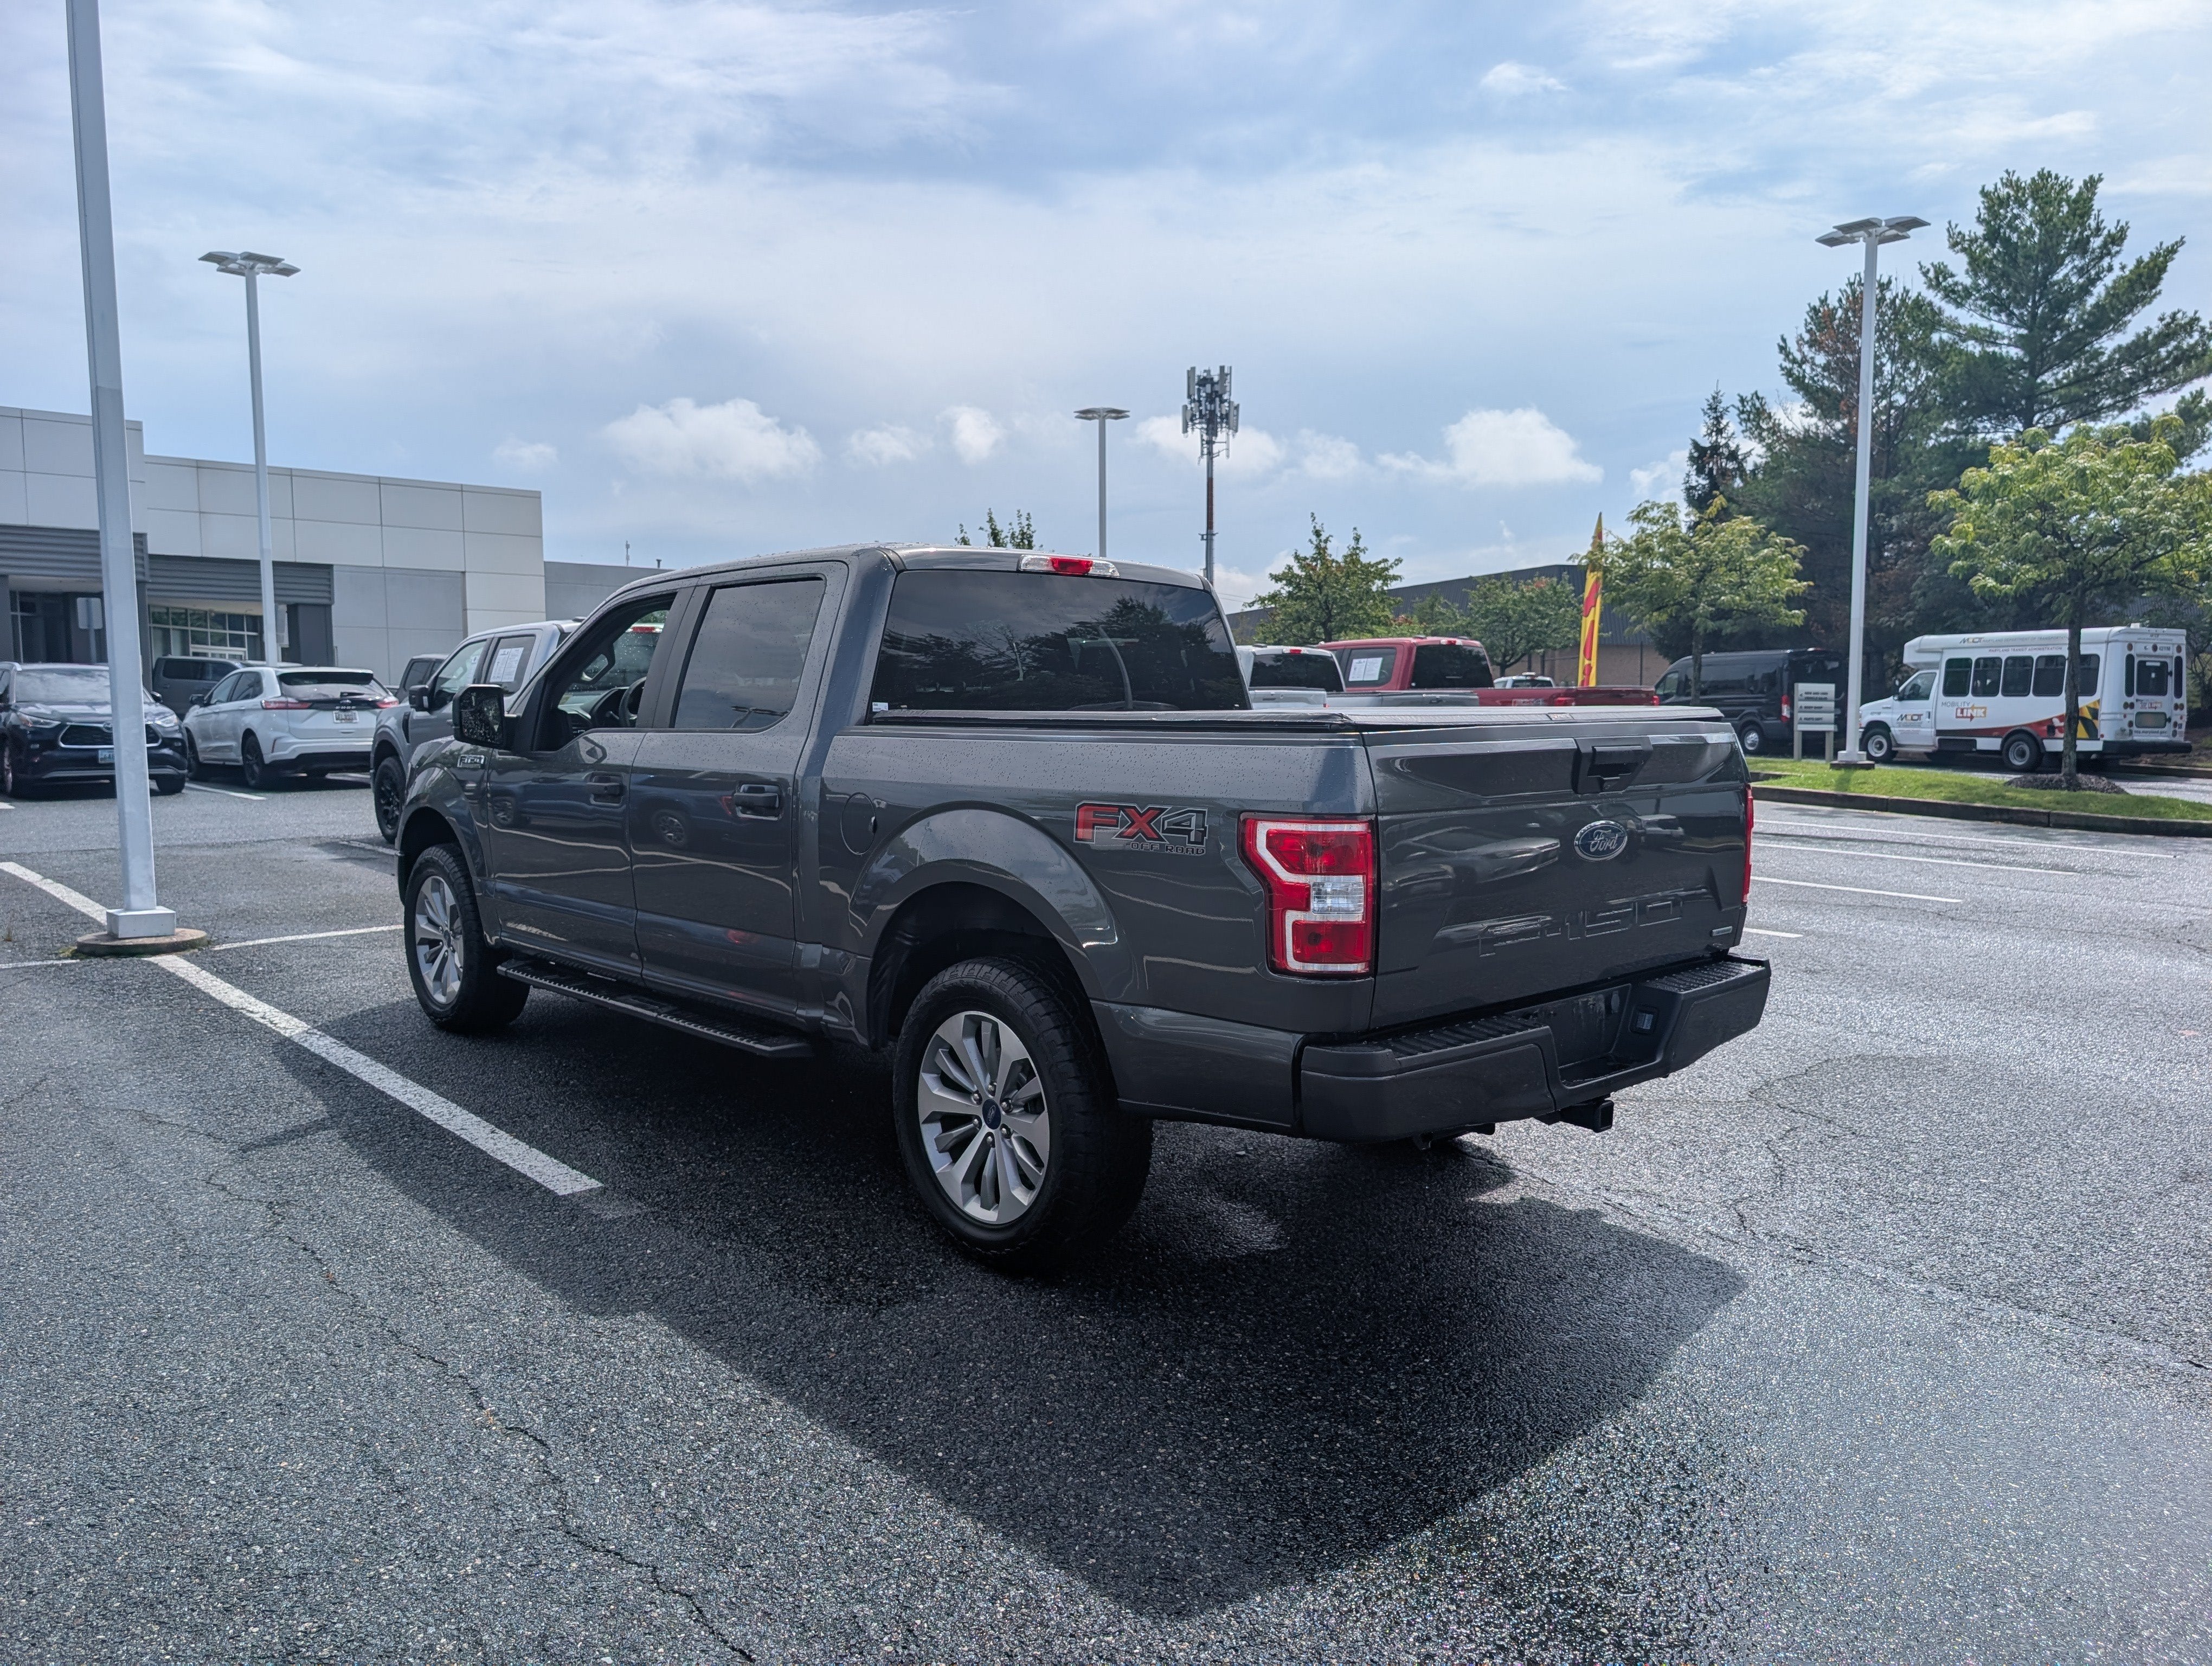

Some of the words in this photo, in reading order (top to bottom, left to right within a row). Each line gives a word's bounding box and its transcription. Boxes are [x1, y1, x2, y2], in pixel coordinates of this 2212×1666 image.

[1957, 708, 1985, 717] LINK
[1074, 800, 1208, 847] FX4
[1130, 842, 1160, 851] OFF
[1165, 845, 1205, 855] ROAD
[1590, 829, 1619, 852] Ford
